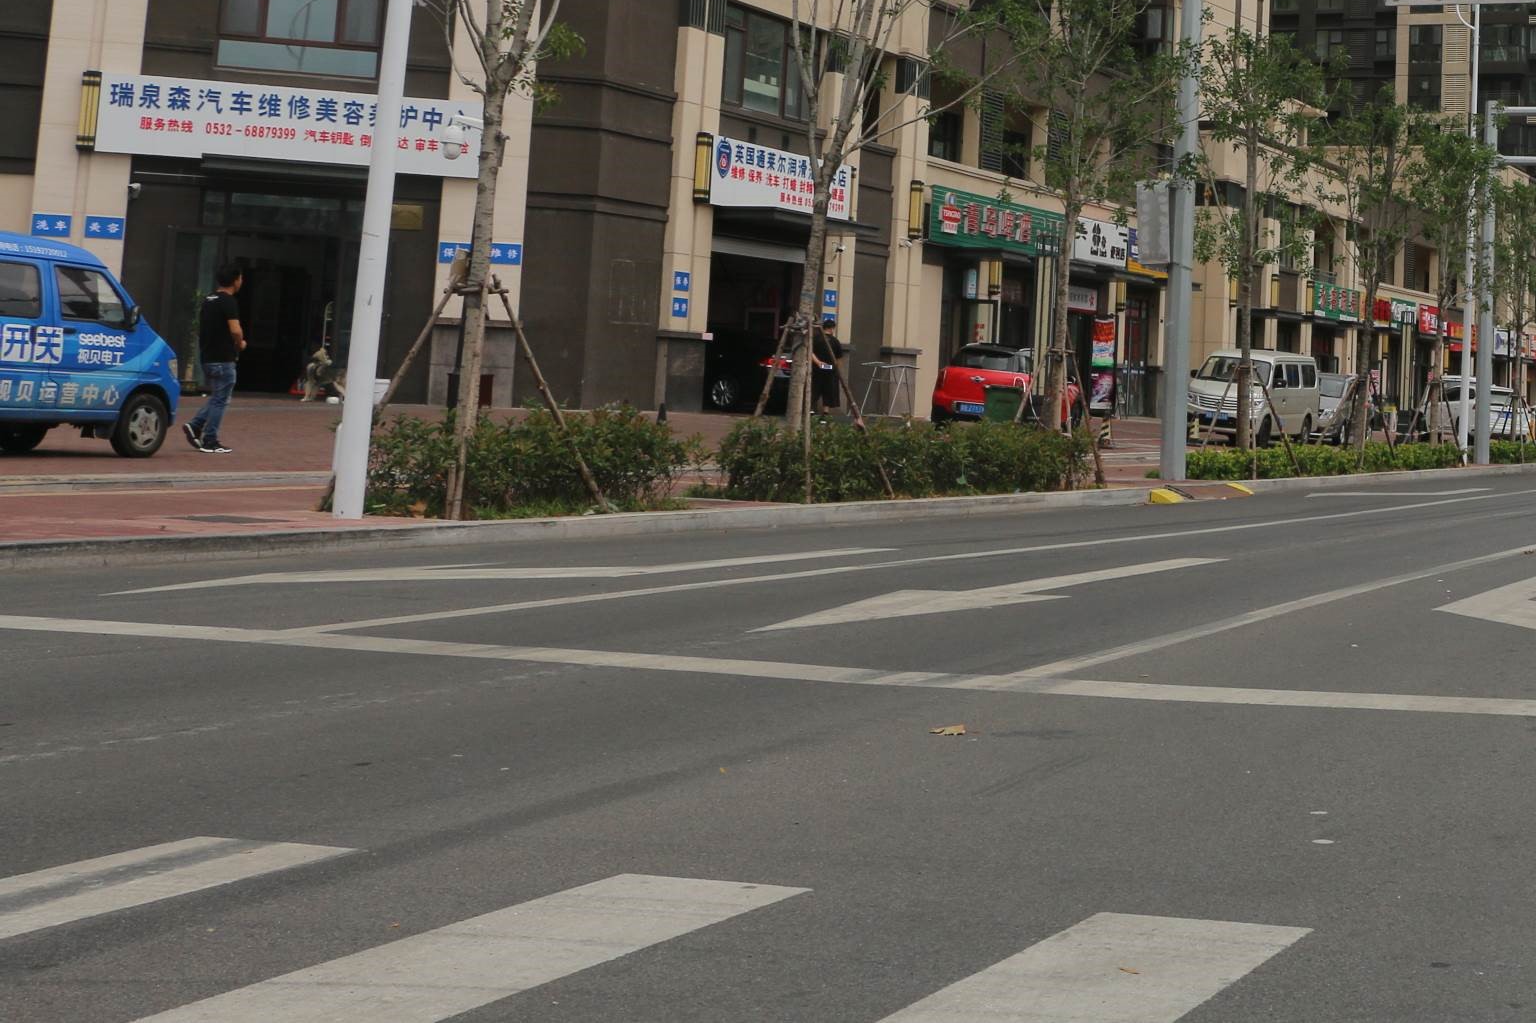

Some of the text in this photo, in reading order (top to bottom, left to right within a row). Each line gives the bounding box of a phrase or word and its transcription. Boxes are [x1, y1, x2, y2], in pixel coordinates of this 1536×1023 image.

[139, 116, 193, 133] 服务热线
[206, 122, 296, 140] 0532-68879399
[304, 129, 354, 146] 汽车钥匙
[360, 134, 408, 150] 倒达
[735, 144, 847, 187] 英国通莱尔润滑店
[79, 333, 126, 348] seebest
[78, 349, 125, 366] 视贝电工
